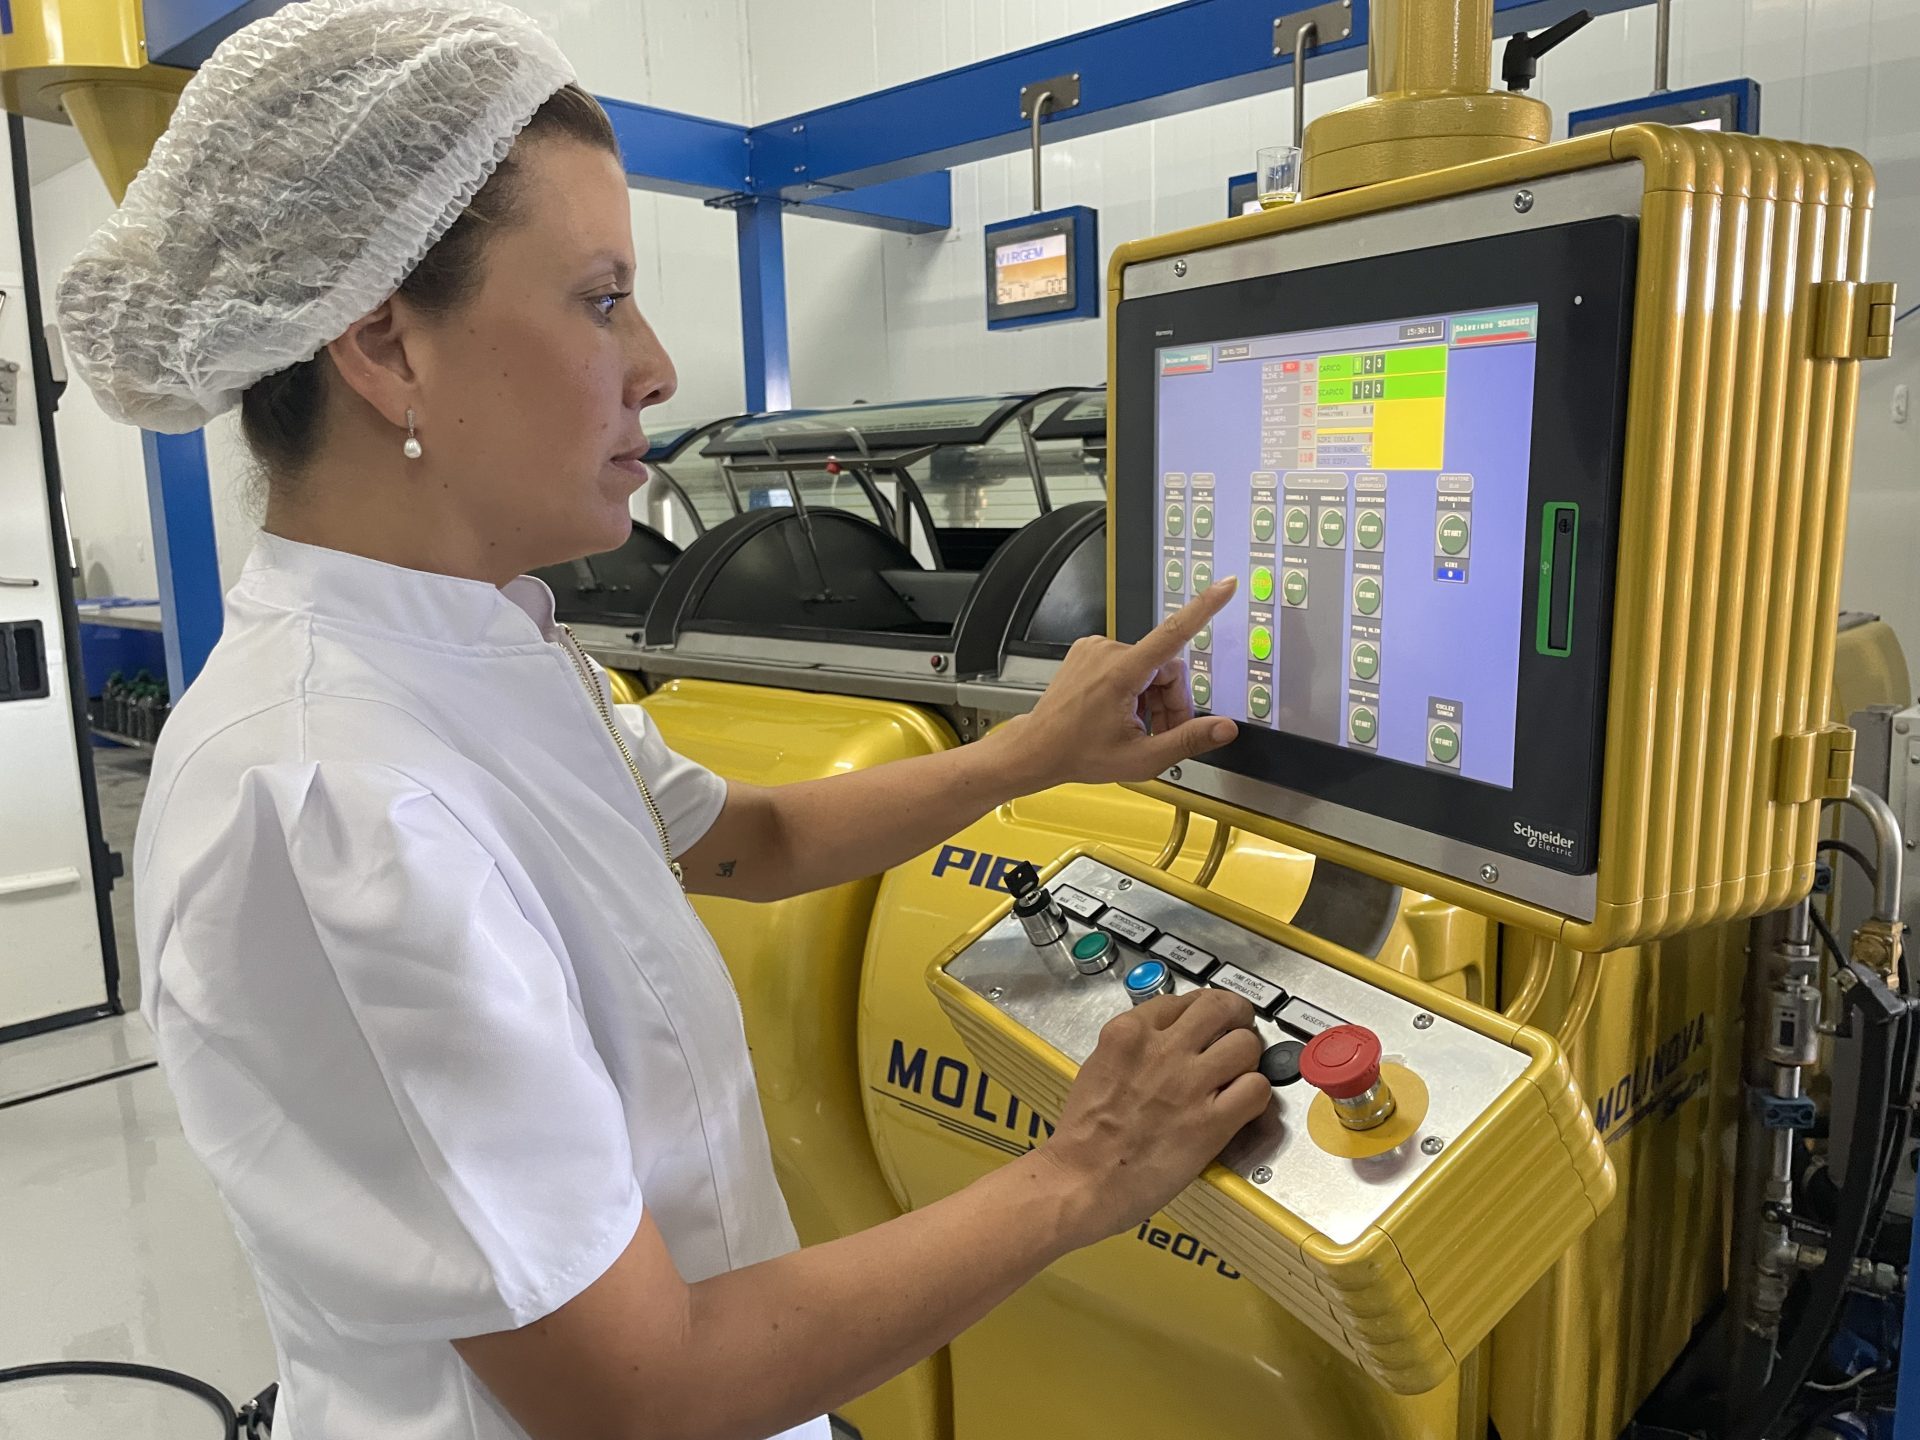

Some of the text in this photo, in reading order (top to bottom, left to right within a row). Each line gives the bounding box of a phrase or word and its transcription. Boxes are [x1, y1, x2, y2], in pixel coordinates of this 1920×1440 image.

[1498, 317, 1529, 328] SCARICO
[1366, 359, 1371, 369] 2
[1377, 358, 1382, 368] 3
[1365, 384, 1370, 394] 2
[1376, 383, 1381, 393] 3
[1359, 591, 1375, 599] START
[1357, 656, 1373, 664] START
[1355, 720, 1371, 728] START
[1435, 738, 1453, 747] START
[1513, 822, 1574, 848] Schneider
[1538, 841, 1573, 857] Electric
[932, 845, 1042, 894] PIE
[1113, 914, 1147, 933] INTRODUCTION
[1169, 951, 1187, 963] RESET
[1176, 945, 1196, 957] ALARM
[1234, 973, 1266, 990] HMI FUNCT.
[1220, 977, 1264, 1002] CONFIRMATION
